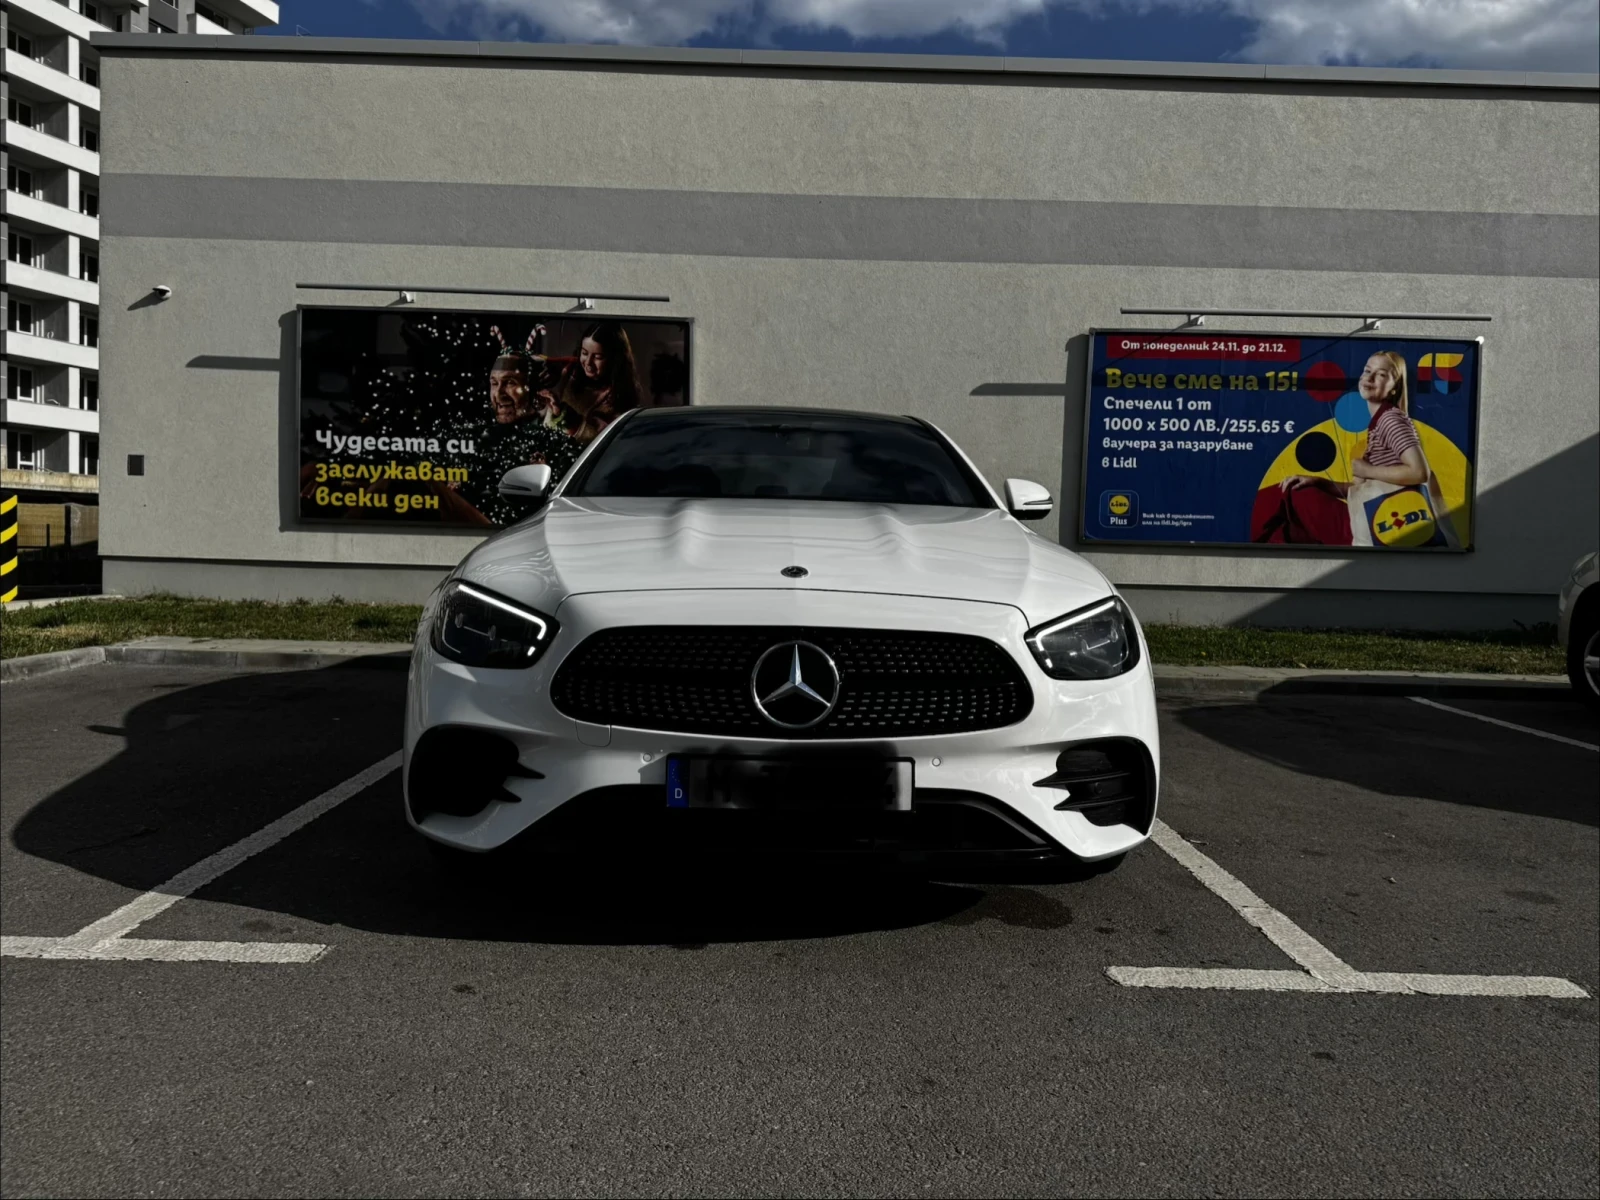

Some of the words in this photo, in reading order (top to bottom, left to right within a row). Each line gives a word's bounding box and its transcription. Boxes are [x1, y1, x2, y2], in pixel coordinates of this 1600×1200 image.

[1121, 340, 1140, 349] От
[1143, 342, 1209, 352] понеделник
[1212, 342, 1240, 351] 24.11.
[1242, 344, 1256, 353] до
[1258, 343, 1286, 352] 21.12.
[1105, 368, 1167, 389] Вече
[1174, 373, 1222, 389] сме
[1229, 375, 1258, 390] на
[1265, 371, 1298, 391] 15!
[1104, 397, 1173, 410] Спечели
[1176, 398, 1183, 410] 1
[1187, 401, 1212, 410] от
[1103, 418, 1143, 431] 1000
[1160, 418, 1190, 431] 500
[1193, 418, 1280, 434] ЛВ./255.65
[1284, 421, 1295, 433] €
[315, 429, 440, 455] Чудесата
[446, 438, 476, 454] си
[1103, 437, 1156, 450] ваучера
[1159, 442, 1174, 451] за
[1177, 439, 1253, 452] пазаруване
[1102, 458, 1110, 467] в
[1113, 457, 1137, 468] Lidl
[315, 460, 468, 483] заслужават
[315, 486, 388, 507] всеки
[394, 494, 439, 513] ден
[1110, 517, 1128, 525] Plus
[674, 787, 683, 799] D
